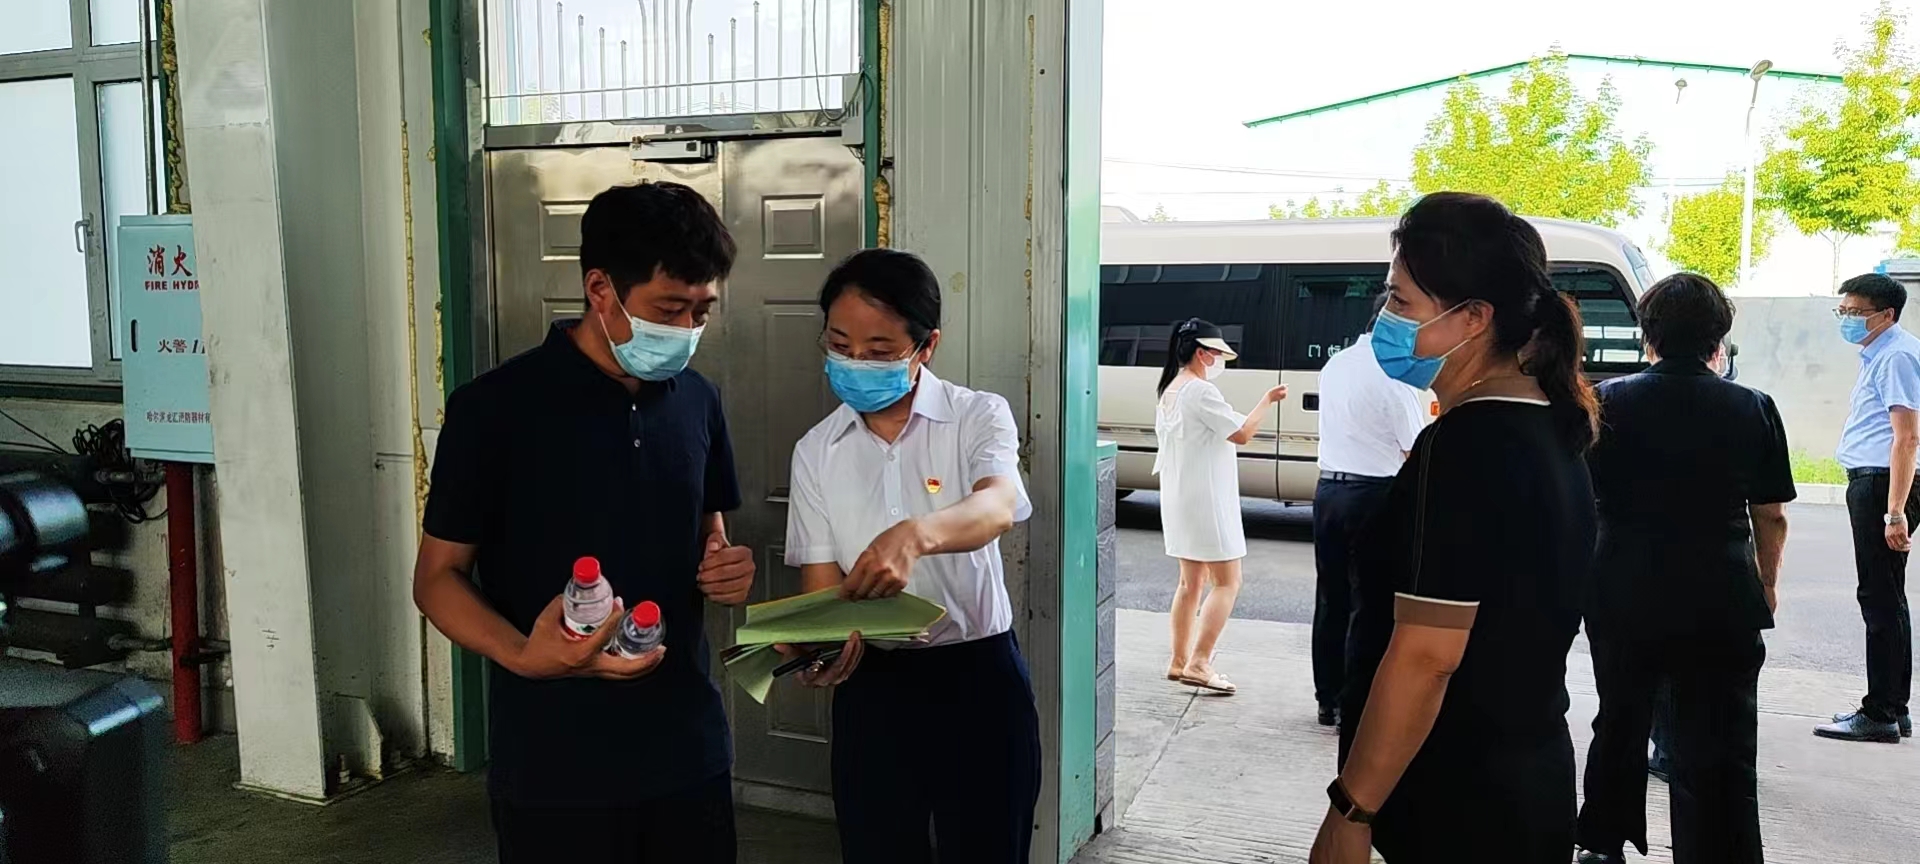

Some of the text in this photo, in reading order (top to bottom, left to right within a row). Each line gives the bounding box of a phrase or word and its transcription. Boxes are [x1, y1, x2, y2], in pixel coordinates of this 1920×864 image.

[147, 244, 193, 278] 消火
[145, 280, 168, 291] FIRE
[157, 339, 187, 353] 火警
